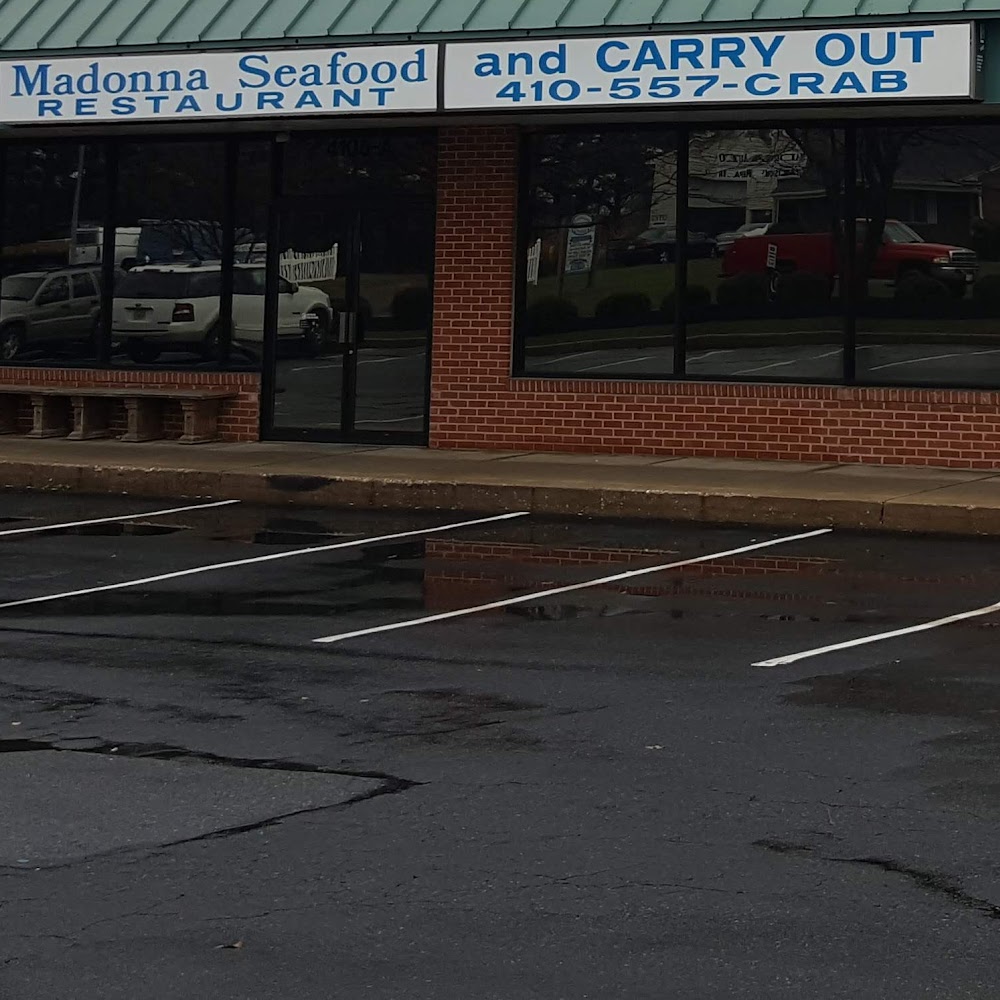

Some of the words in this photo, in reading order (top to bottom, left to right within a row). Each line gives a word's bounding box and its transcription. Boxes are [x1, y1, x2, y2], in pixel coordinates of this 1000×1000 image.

[11, 62, 209, 97] Madonna
[238, 49, 427, 89] Seafood
[474, 43, 567, 77] and
[595, 34, 786, 73] CARRY
[815, 29, 936, 68] OUT
[37, 88, 395, 116] RESTAURANT
[496, 70, 909, 102] 410-557-CRAB
